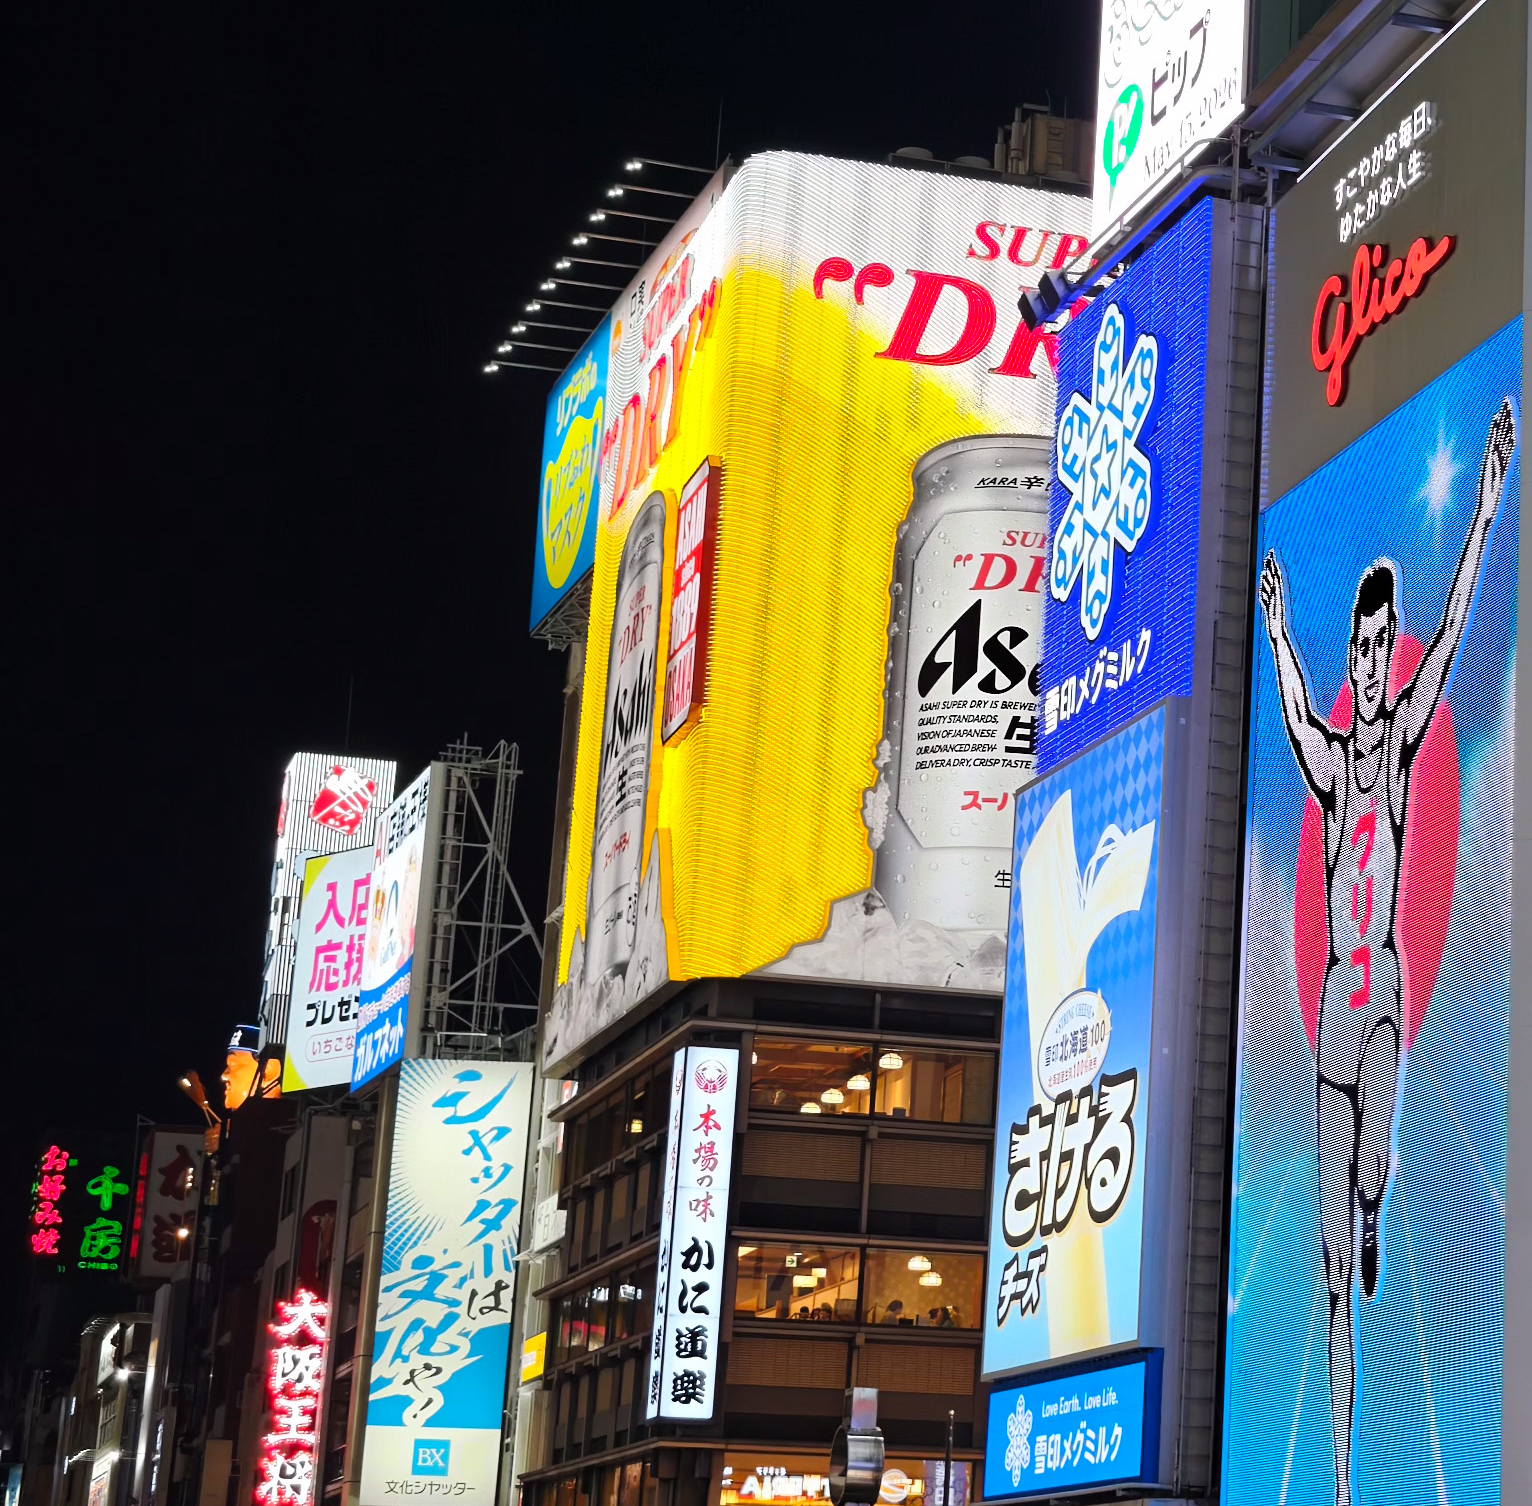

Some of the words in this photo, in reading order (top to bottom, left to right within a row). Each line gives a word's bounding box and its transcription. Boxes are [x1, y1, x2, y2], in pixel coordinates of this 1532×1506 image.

[1151, 9, 1211, 126] ピップ
[1334, 100, 1432, 209] すこやかな毎日、
[1340, 149, 1422, 242] ゆたかな人生
[1311, 235, 1451, 406] Glico
[670, 572, 701, 658] 1889
[918, 598, 1040, 698] As
[664, 644, 695, 728] OSAKA
[918, 715, 949, 727] QUALITY
[949, 714, 999, 725] STANDARDS,
[919, 701, 941, 712] ASAHI
[941, 700, 968, 710] SUPER
[969, 699, 988, 709] DRY
[989, 700, 999, 709] IS
[1044, 627, 1152, 736] 雪印メグミルク
[915, 760, 947, 771] DELIVER
[952, 758, 973, 768] DRY,
[972, 758, 1001, 768] CRISP
[1001, 759, 1032, 770] TASTE
[916, 746, 930, 756] OUR
[930, 744, 970, 755] ADVANCED
[970, 743, 998, 753] BREW-
[917, 730, 941, 741] VISION
[941, 730, 952, 740] OF
[951, 729, 998, 739] JAPANESE
[1349, 797, 1378, 1011] グリコ
[32, 1145, 70, 1254] お好み焼
[687, 1103, 722, 1224] 本場の味
[1002, 1067, 1138, 1247] さける
[80, 1165, 130, 1260] 千房
[671, 1236, 715, 1405] かに道楽
[998, 1245, 1048, 1327] チーズ
[264, 1289, 329, 1506] 大阪王将
[1042, 1400, 1059, 1419] Love
[1059, 1395, 1081, 1415] Earth.
[1084, 1392, 1101, 1409] Love
[1102, 1387, 1119, 1407] Life.
[416, 1447, 446, 1468] BX
[1034, 1420, 1123, 1475] 雪印メグミルク
